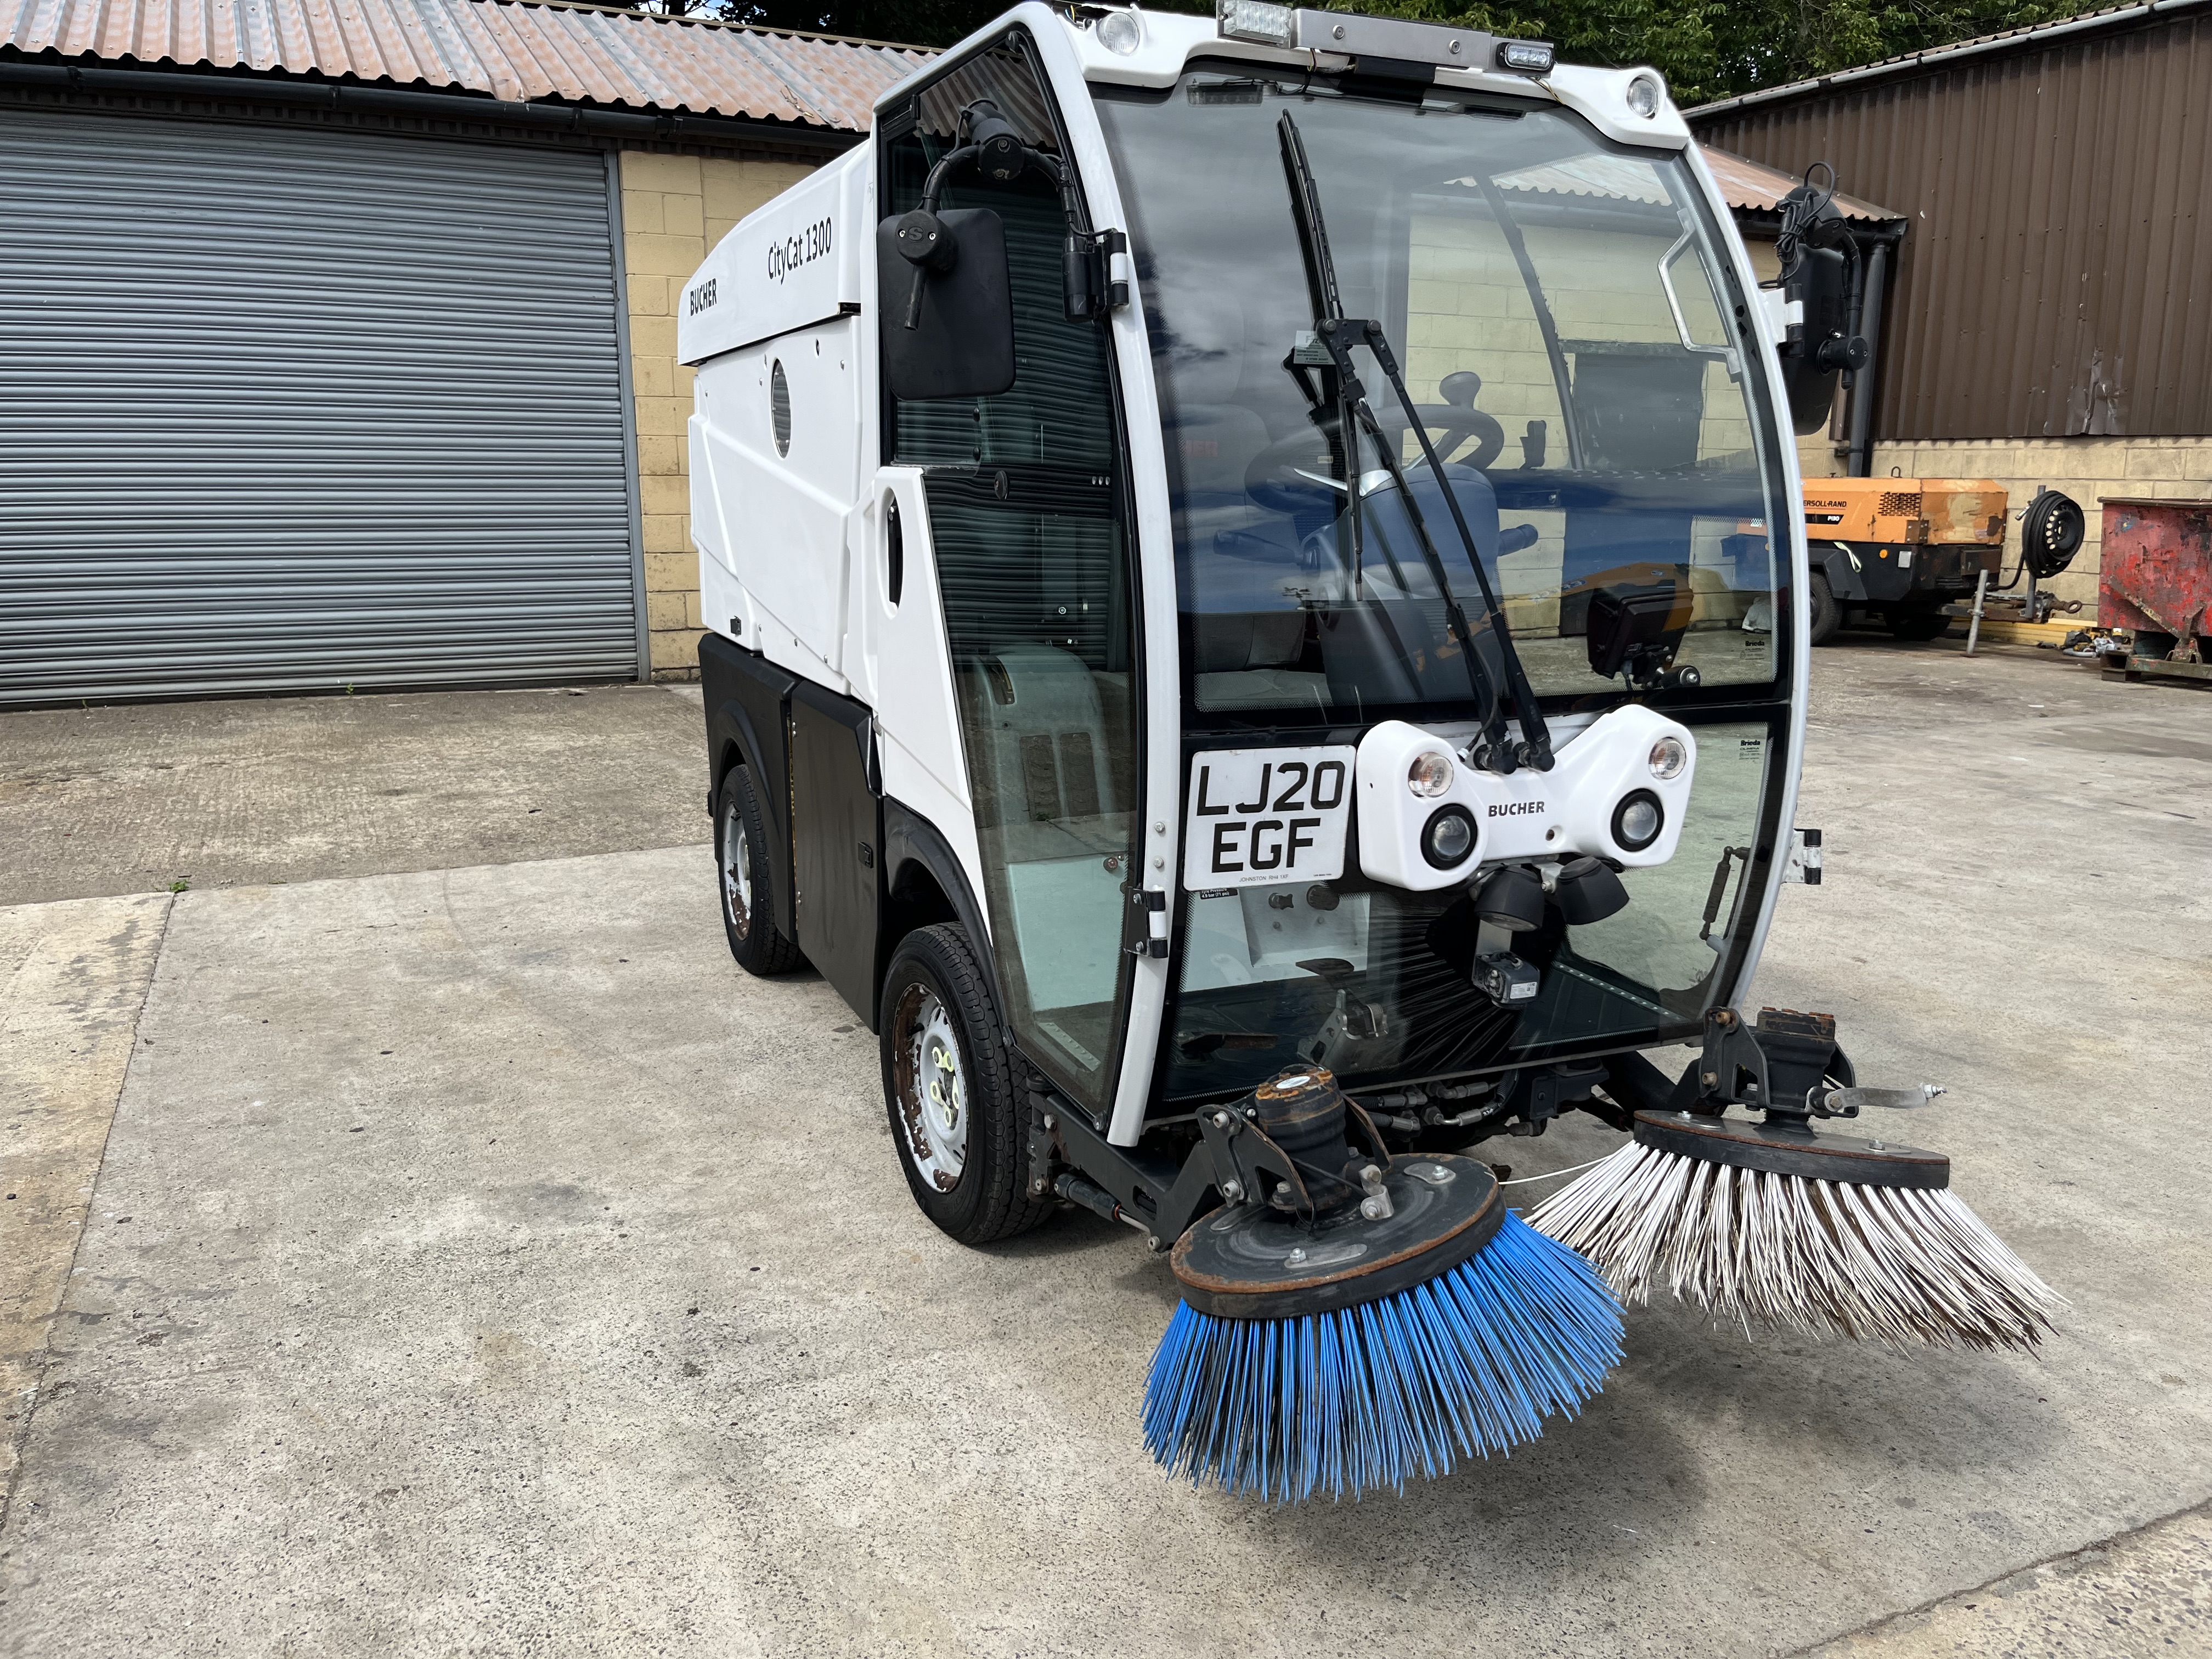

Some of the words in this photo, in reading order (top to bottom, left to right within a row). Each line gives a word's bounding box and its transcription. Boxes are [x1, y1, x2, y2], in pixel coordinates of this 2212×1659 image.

[768, 234, 803, 285] CityCat
[806, 216, 832, 263] 1300
[690, 278, 717, 316] BUCHER
[1196, 760, 1346, 816] LJ20
[1488, 801, 1545, 817] BUCHER
[1211, 817, 1321, 873] EGF
